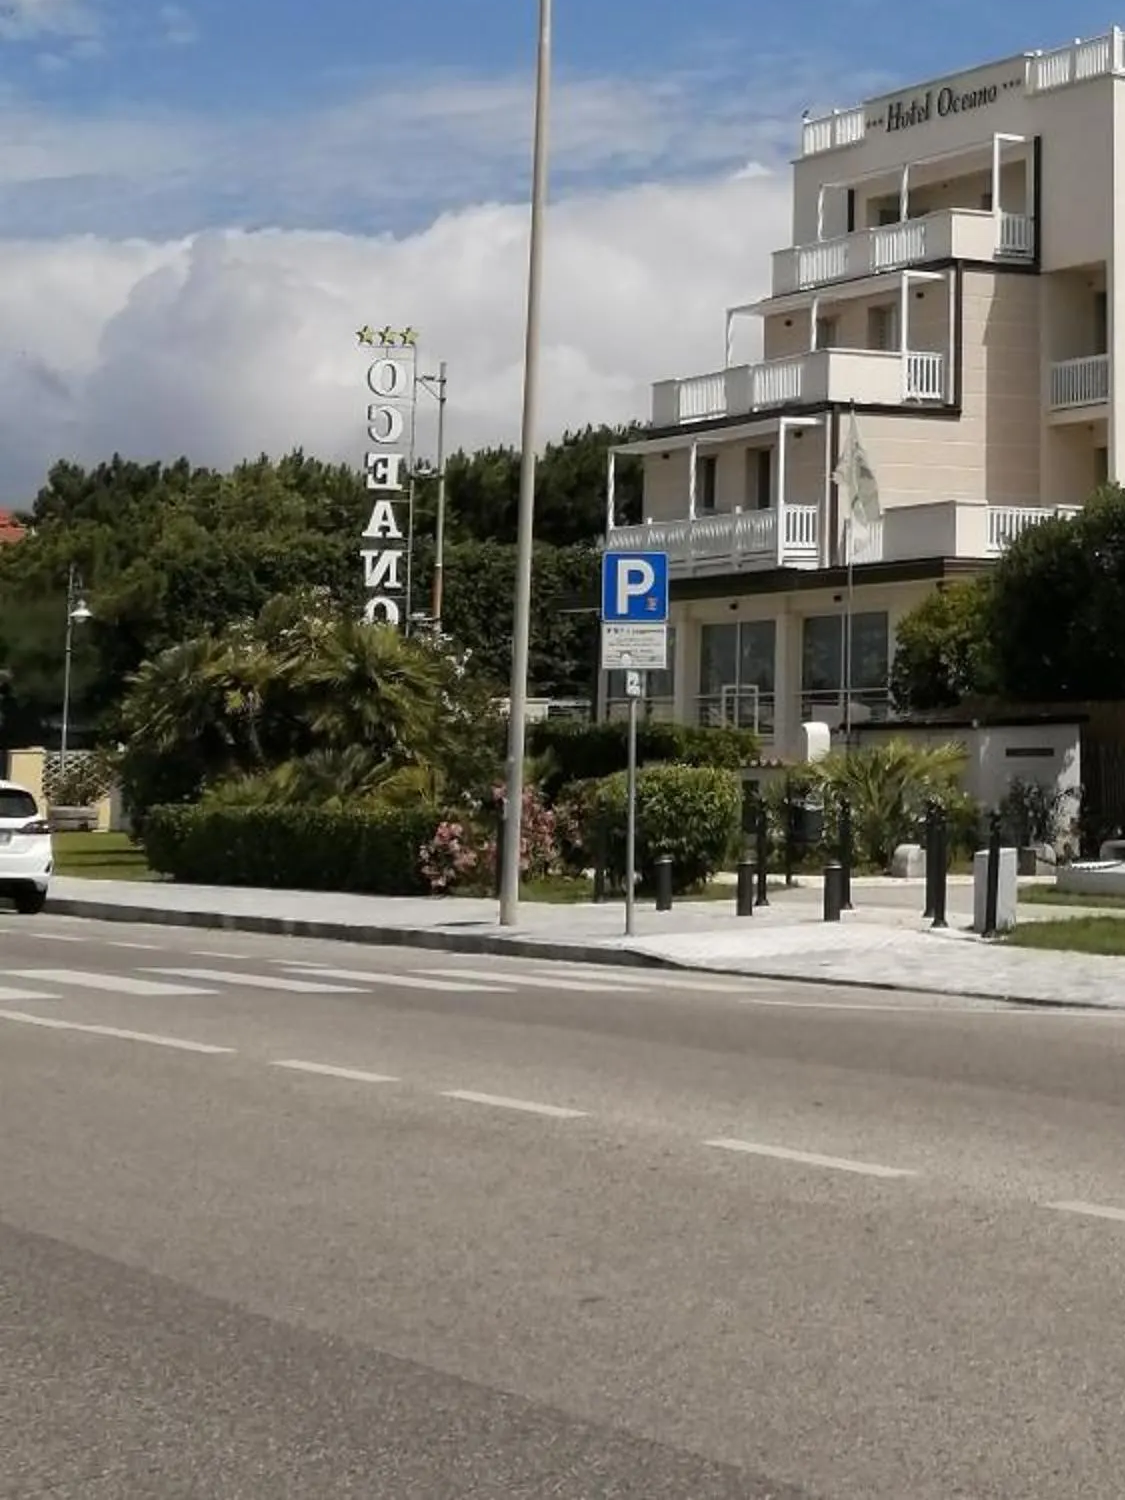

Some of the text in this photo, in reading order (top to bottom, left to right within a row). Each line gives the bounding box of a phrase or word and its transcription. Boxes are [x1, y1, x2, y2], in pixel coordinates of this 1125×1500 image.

[886, 85, 998, 132] Hotel Oceano
[617, 559, 655, 615] P
